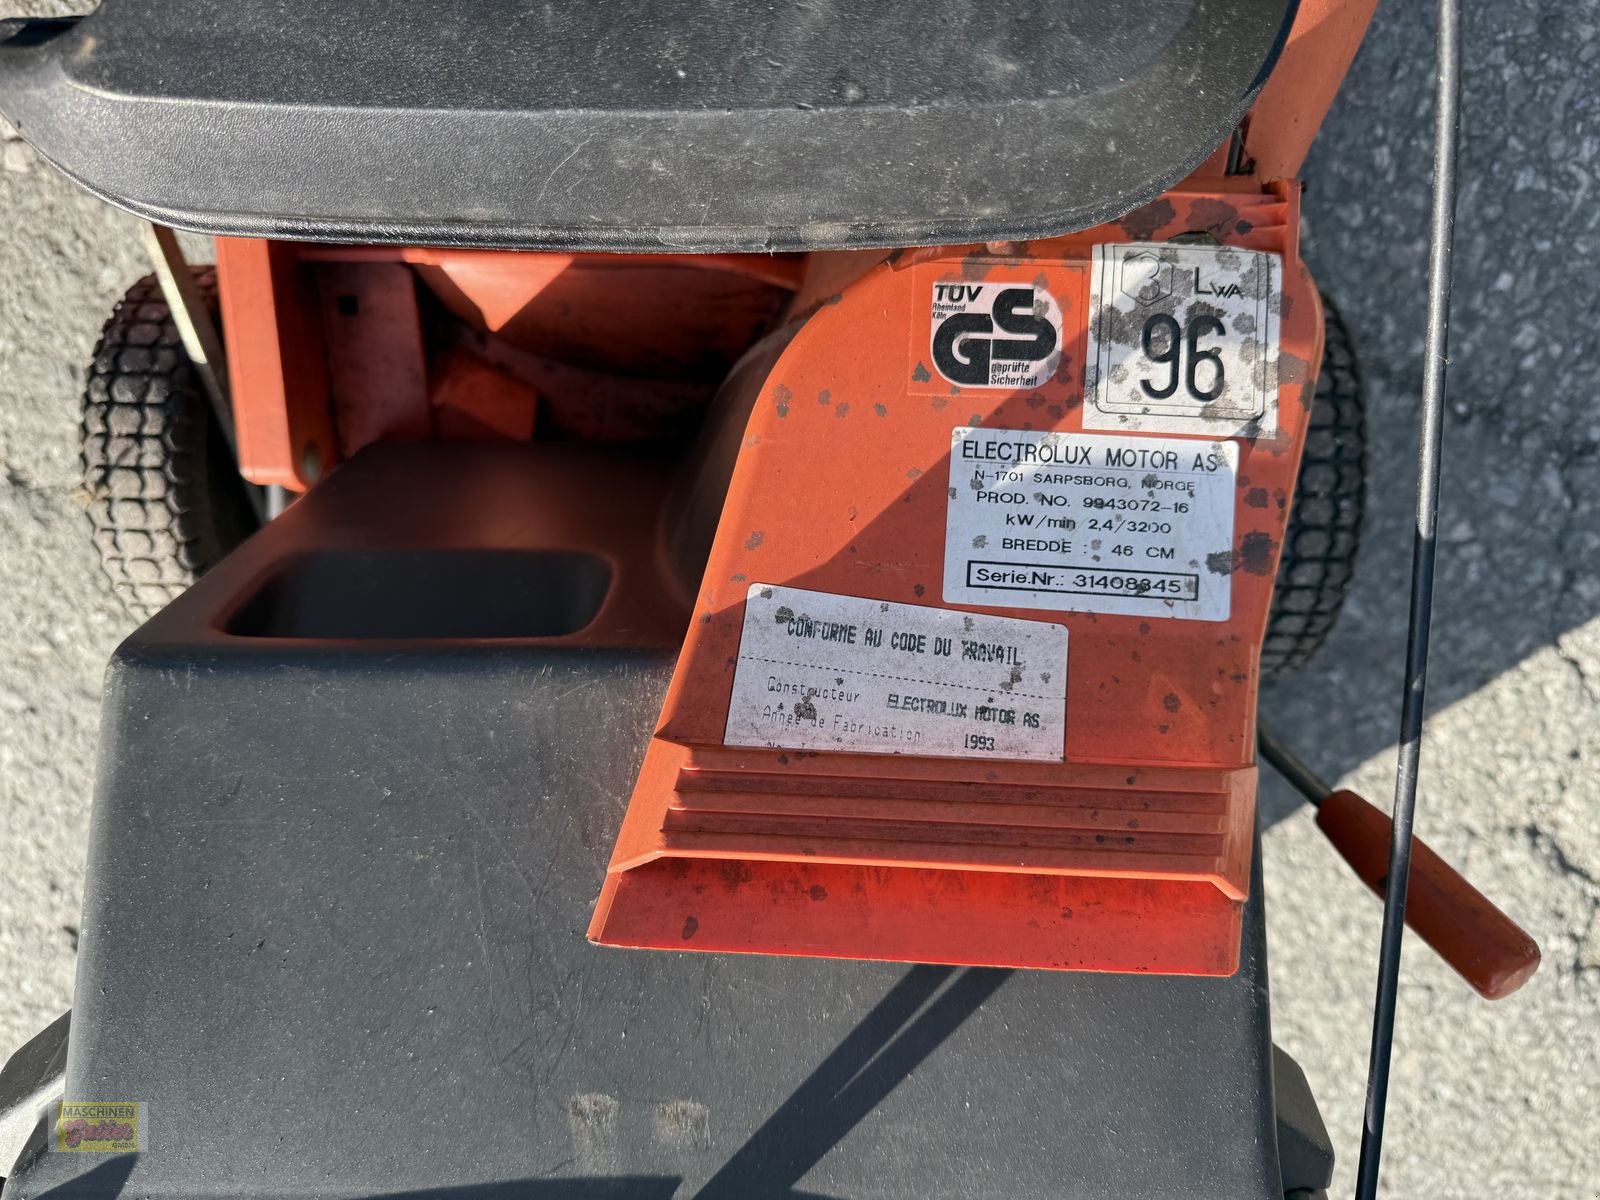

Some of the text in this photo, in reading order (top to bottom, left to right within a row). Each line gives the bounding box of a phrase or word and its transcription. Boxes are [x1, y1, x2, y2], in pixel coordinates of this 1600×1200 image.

[932, 303, 966, 312] Rheinland
[991, 362, 1030, 374] geprüfte
[1140, 313, 1226, 402] 96
[991, 375, 1037, 386] Sicherheit
[962, 440, 1218, 472] ELECTROLUX MOTOR AS
[974, 470, 1196, 492] N-1701 SARPSBORG, NORGE
[976, 491, 1189, 513] PROD. NO. 9943072-16
[1006, 513, 1172, 534] kW/min 2,4/3200
[1002, 538, 1072, 553] BREDDE
[1111, 545, 1134, 556] 46
[1145, 547, 1175, 560] CM
[787, 617, 1023, 666] CONFORME AU CODE DU TRAVAIL
[767, 675, 1040, 729] Constructeur ELECTROLUX MOTOR AS
[833, 714, 921, 742] Fabrication
[964, 733, 995, 751] 1993
